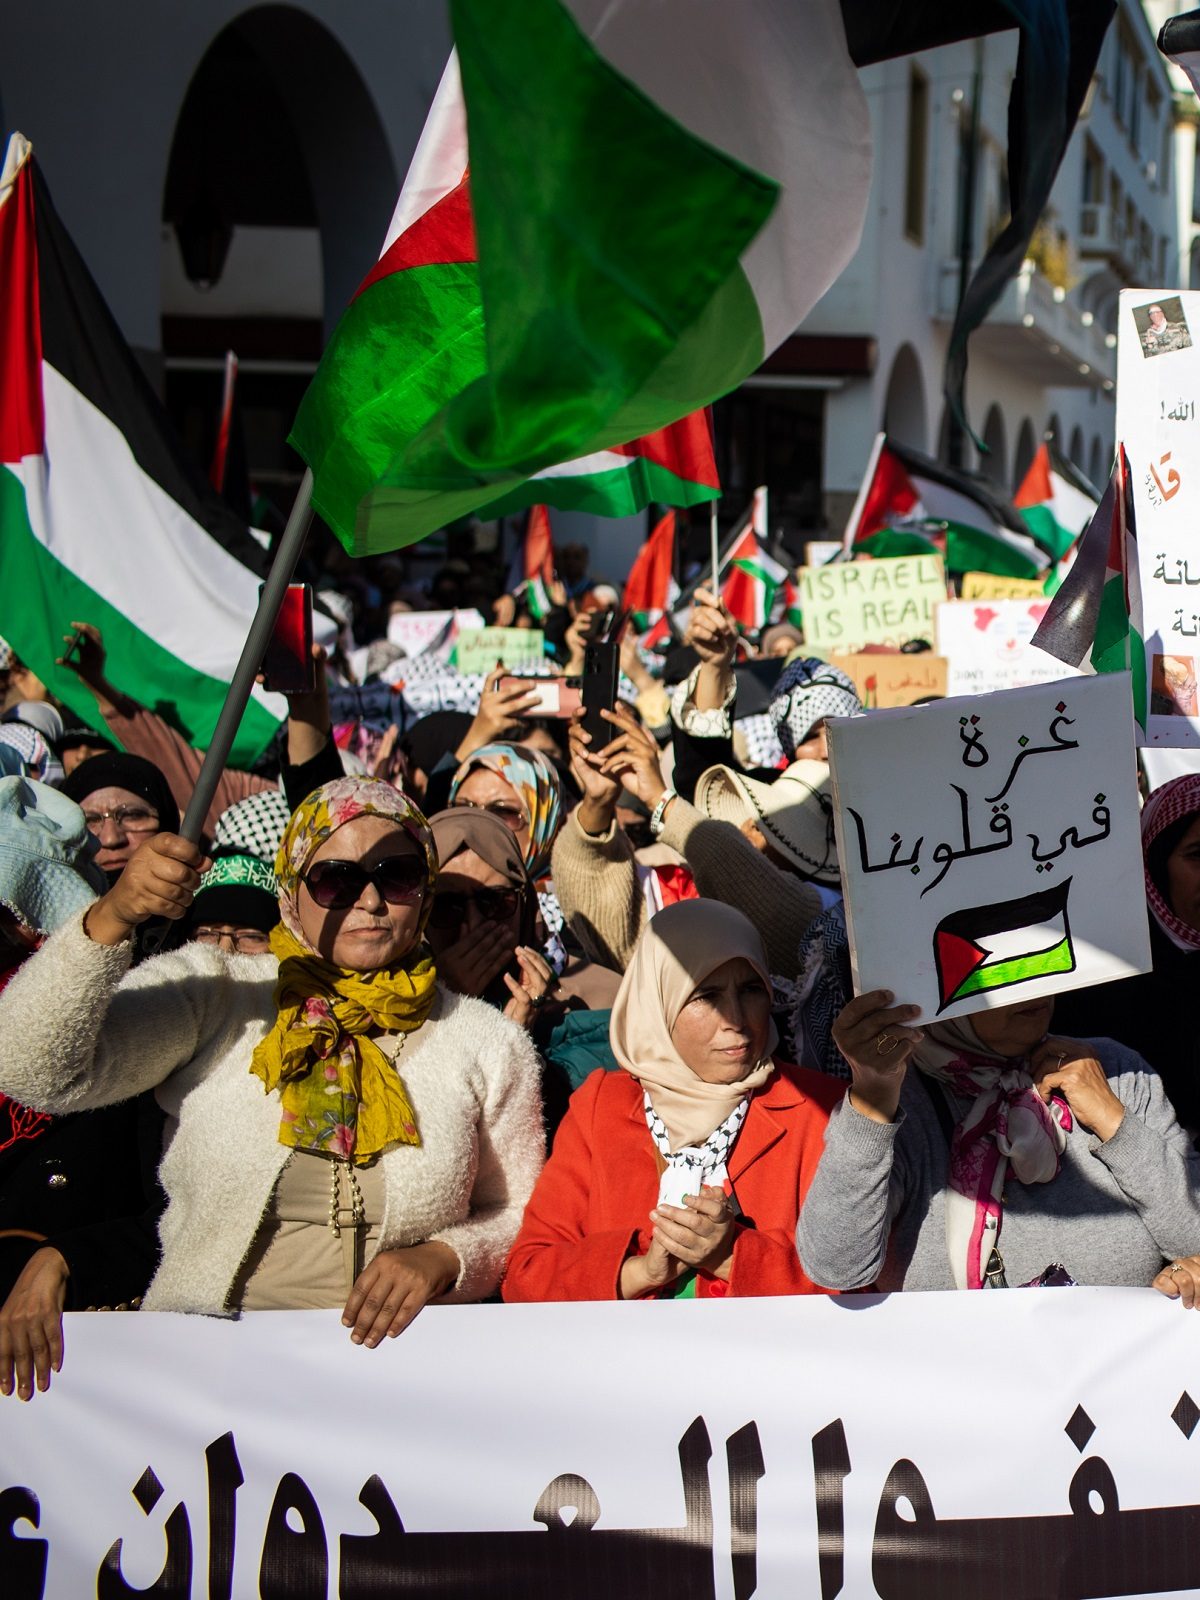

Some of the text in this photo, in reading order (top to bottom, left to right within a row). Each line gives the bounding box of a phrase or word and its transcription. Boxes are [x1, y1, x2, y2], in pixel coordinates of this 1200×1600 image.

[804, 563, 940, 601] ISRAEL
[812, 597, 934, 640] IS REAL
[959, 701, 1080, 803] غزة
[846, 783, 1111, 900] في قلوبنا
[96, 1414, 767, 1600] العدوان
